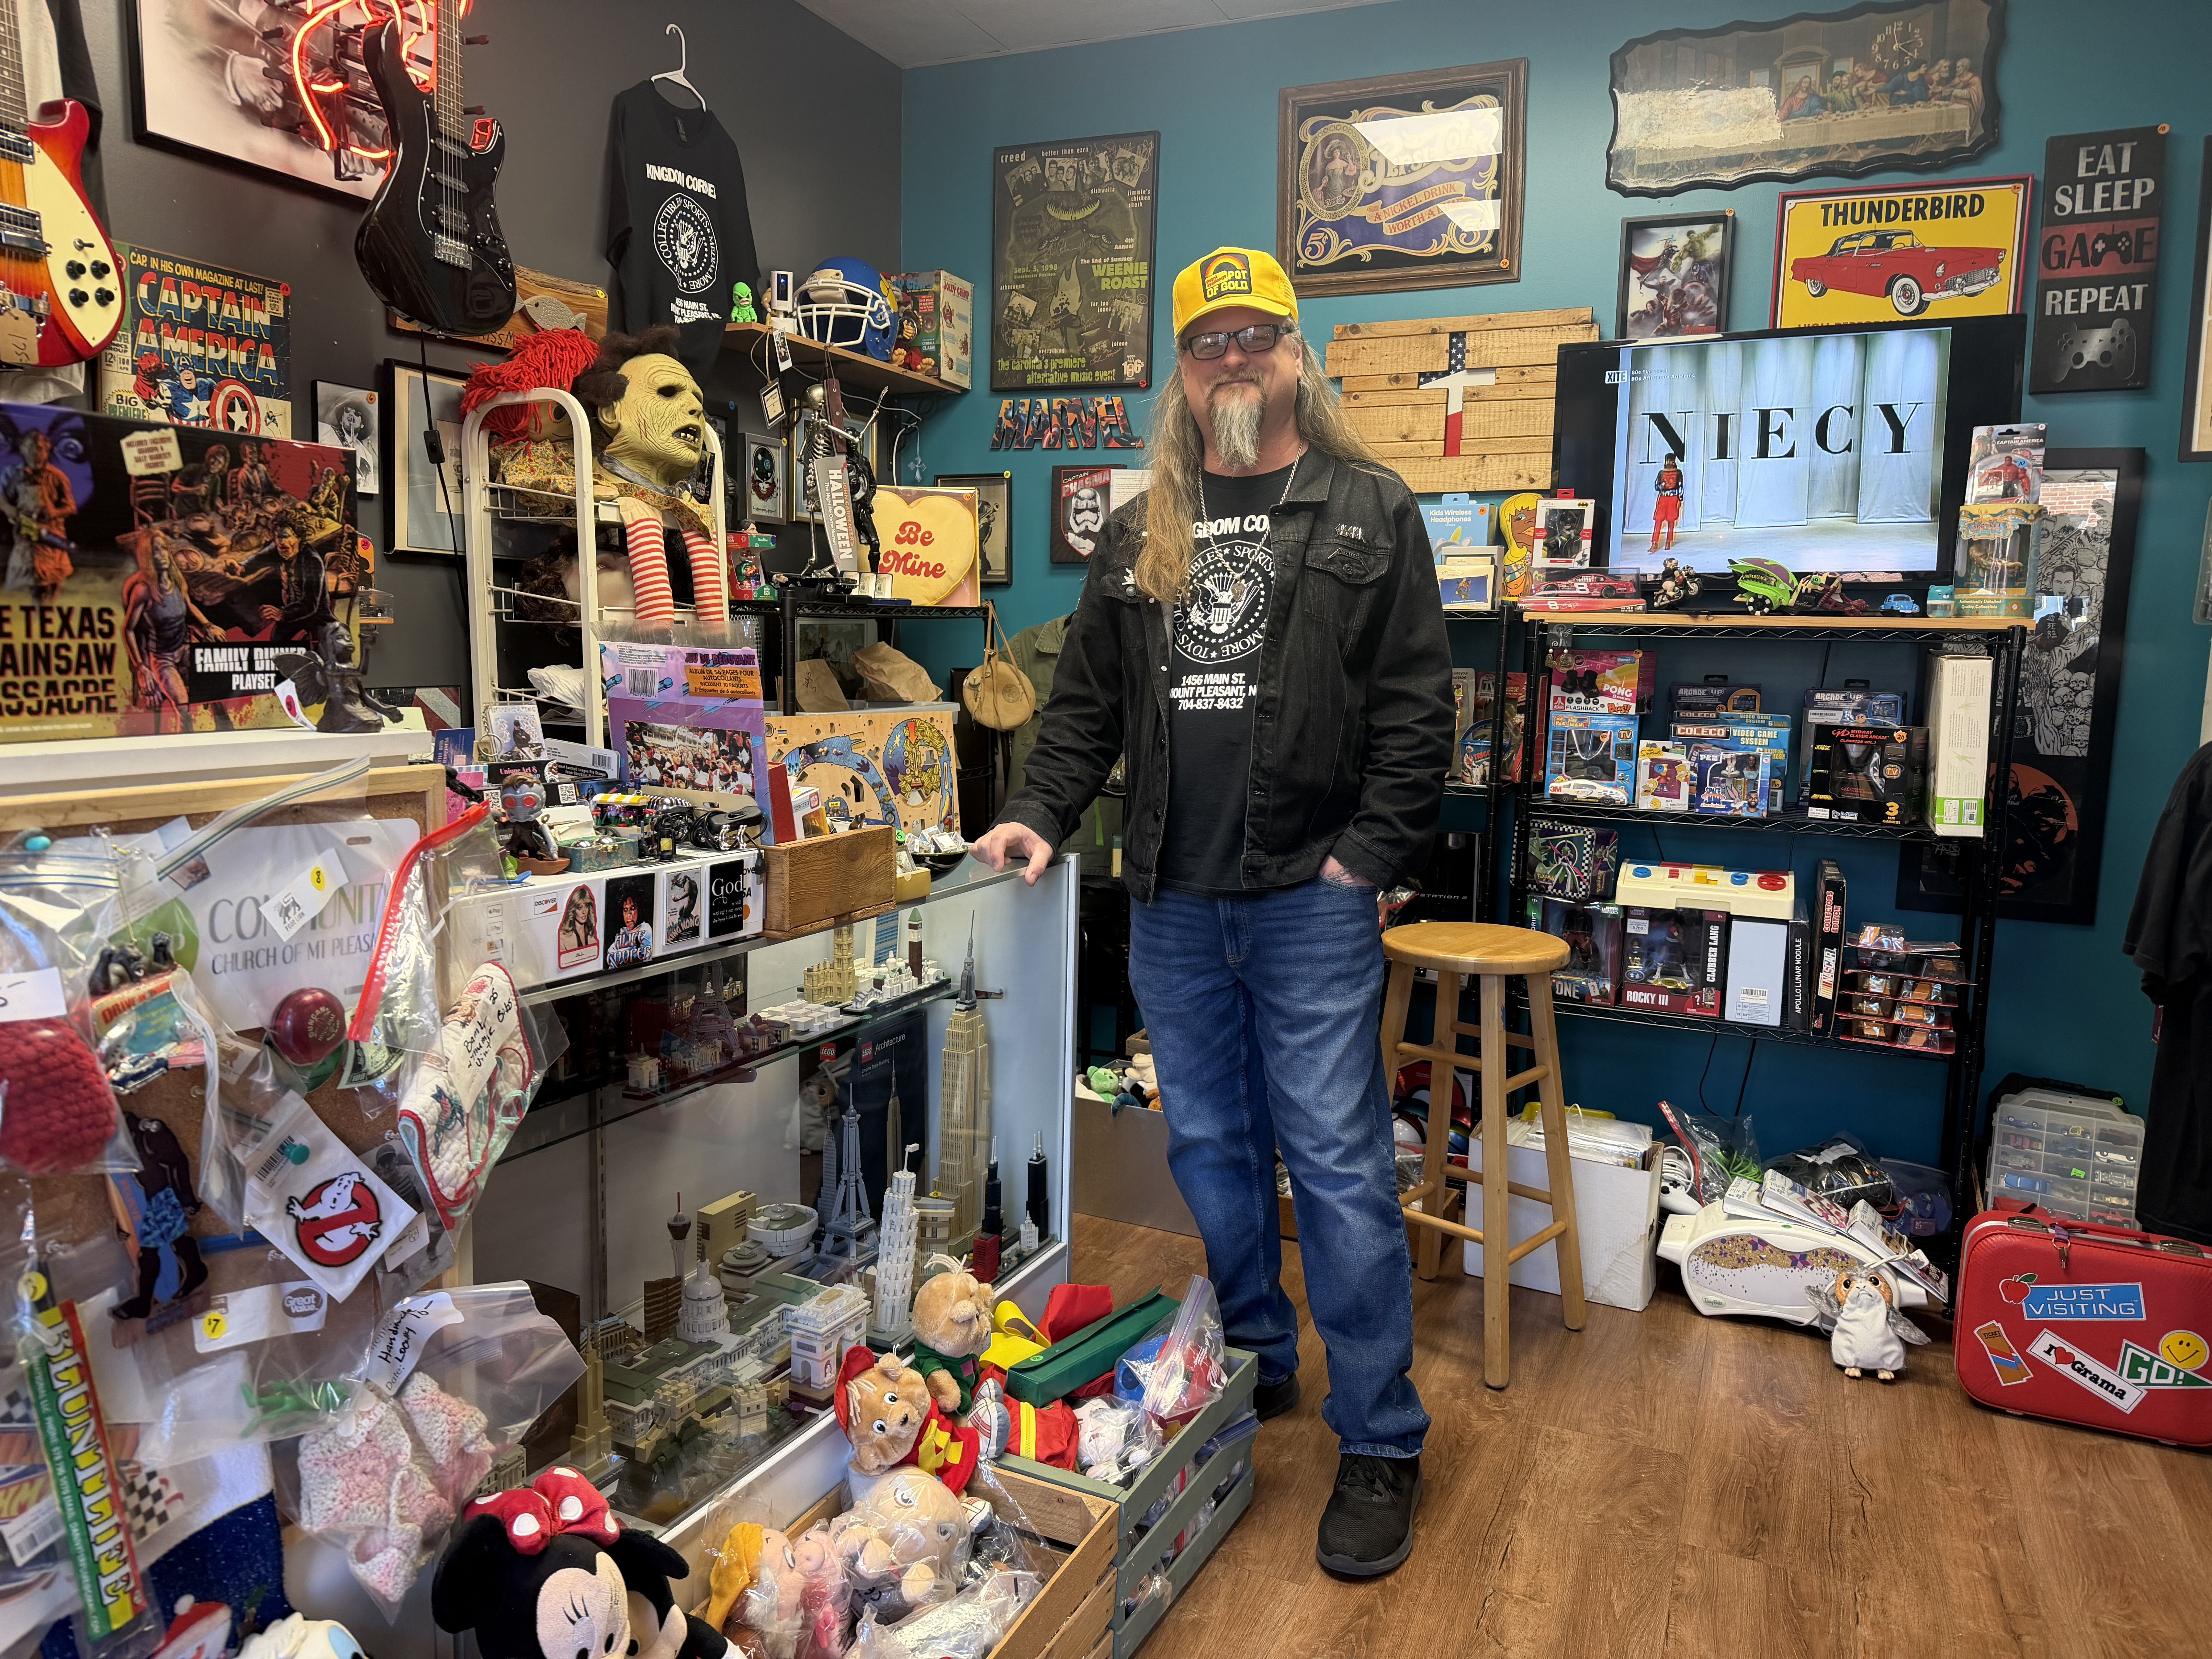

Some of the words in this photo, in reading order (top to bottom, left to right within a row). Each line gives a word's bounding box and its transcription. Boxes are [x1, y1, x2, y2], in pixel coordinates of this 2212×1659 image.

[1884, 59, 1889, 69] 7
[1893, 60, 1899, 69] 6
[1001, 151, 1025, 163] creed
[1041, 148, 1058, 156] better
[2078, 142, 2137, 177] EAT
[1374, 211, 1382, 221] A
[1383, 196, 1421, 219] NICKEL
[1425, 184, 1457, 201] DRINK
[2054, 178, 2155, 216] SLEEP
[684, 199, 709, 227] SPORTS
[1820, 194, 1984, 227] THUNDERBIRD
[1388, 214, 1426, 233] WORTH
[151, 257, 158, 269] IN
[160, 260, 173, 273] HIS
[175, 263, 194, 278] OWN
[195, 269, 234, 287] MAGAZINE
[235, 280, 243, 290] AT
[245, 281, 264, 294] LAST!
[1014, 265, 1030, 274] Sept.
[1041, 264, 1058, 272] 1998
[1091, 262, 1148, 277] WEENIE
[1228, 270, 1247, 280] POT
[689, 271, 713, 290] MORE
[1101, 276, 1148, 290] ROAST
[1206, 285, 1219, 298] OF
[1221, 280, 1249, 292] GOLD
[137, 271, 270, 340] CAPTAIN
[2045, 284, 2148, 315] REPEAT
[133, 318, 279, 386] AMERICA
[998, 359, 1010, 371] the
[1051, 357, 1085, 370] premiere
[1027, 371, 1068, 384] alternative
[1070, 369, 1092, 383] music
[1095, 368, 1115, 381] event
[1607, 372, 1626, 382] XITE
[116, 394, 138, 407] BIG
[991, 397, 1145, 448] MARVEL
[1640, 402, 1924, 464] NIECY
[1062, 470, 1110, 498] PHASMA
[1063, 471, 1089, 484] CAPTAIN
[828, 469, 853, 559] HALLOWEEN
[895, 521, 934, 546] Be
[879, 550, 946, 579] Mine
[1233, 545, 1274, 572] SPORTS
[1574, 582, 1590, 594] 8
[1547, 601, 1559, 610] 8
[24, 605, 115, 639] TEXAS
[1178, 634, 1209, 659] TOYS
[1221, 629, 1265, 657] MORE
[195, 647, 249, 673] FAMILY
[232, 673, 275, 690] PLAYSET
[1181, 674, 1203, 687] 1456
[1204, 673, 1230, 685] MAIN
[1231, 673, 1246, 685] ST.
[1195, 685, 1246, 698] PLEASANT,
[1603, 684, 1633, 697] PONG
[1178, 697, 1244, 710] 704-837-8432
[1677, 728, 1726, 736] COLECO
[1733, 729, 1755, 737] VIDEO
[1757, 730, 1778, 738] GAME
[1740, 737, 1769, 746] SYSTEM
[1886, 802, 1899, 816] 3
[712, 874, 743, 906] God
[535, 898, 556, 907] DISCOVER
[1823, 891, 1834, 933] COLLECTORS
[1832, 905, 1841, 933] EDITION
[666, 925, 682, 943] KING
[681, 916, 700, 932] KONG
[1709, 925, 1719, 946] LANG
[614, 931, 646, 949] ALICE
[212, 946, 277, 975] CHURCH
[282, 943, 303, 964] OF
[307, 939, 325, 960] MT
[606, 946, 652, 965] COOPER
[1706, 947, 1718, 982] CLUBBER
[1821, 948, 1837, 984] NASCAR
[1555, 981, 1580, 1000] ONE
[1626, 991, 1656, 1004] ROCKY
[1658, 994, 1668, 1006] III
[821, 1047, 835, 1056] LEGO
[862, 1048, 872, 1057] LEGO
[875, 1033, 905, 1055] Architecture
[879, 1058, 890, 1067] Building
[283, 1294, 316, 1309] Great
[2046, 1288, 2111, 1301] JUST
[2028, 1302, 2136, 1316] VISITING
[208, 1317, 219, 1334] $7
[2044, 1344, 2057, 1357] I
[2071, 1360, 2127, 1401] Grama
[2126, 1348, 2185, 1385] GO!
[43, 1321, 136, 1607] BLUNTLIFE
